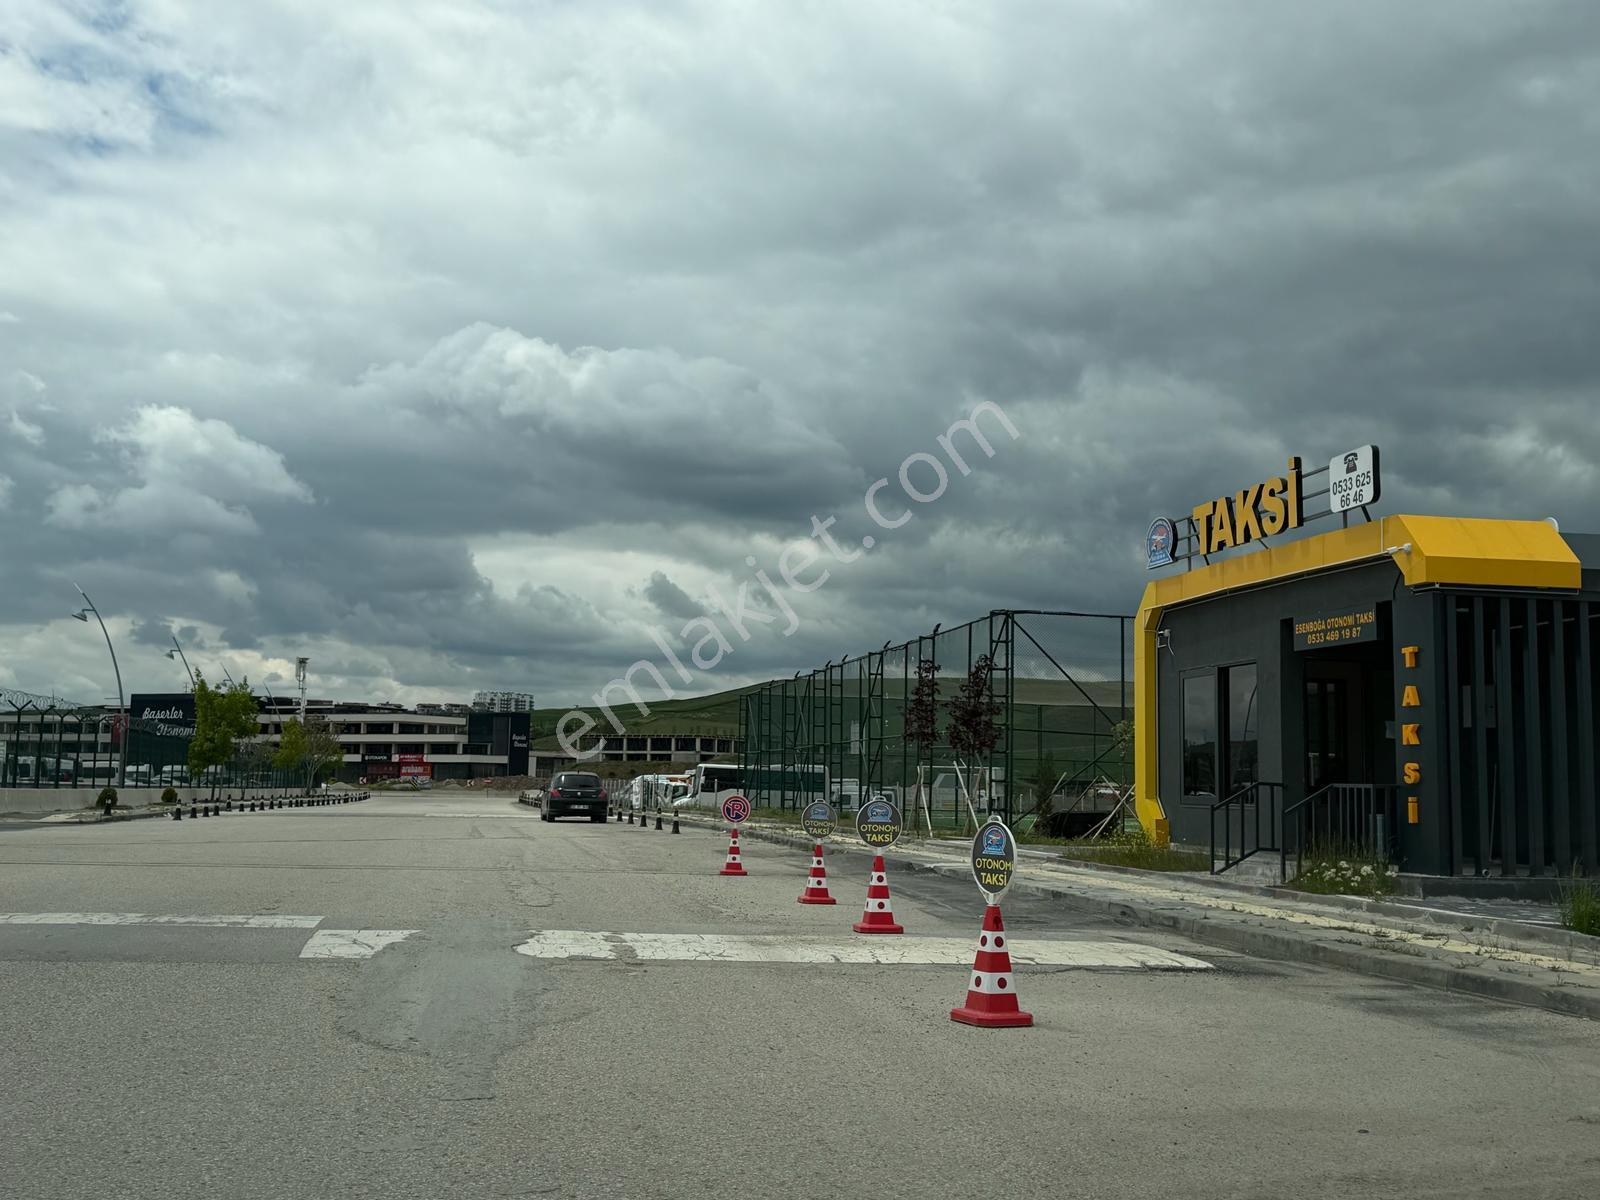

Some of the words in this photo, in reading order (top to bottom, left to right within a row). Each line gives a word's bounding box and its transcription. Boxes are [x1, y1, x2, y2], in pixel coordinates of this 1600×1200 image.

[1332, 477, 1353, 496] 0533
[1355, 470, 1371, 488] 625
[1192, 457, 1303, 556] TAKSİ
[1340, 493, 1351, 508] 66
[1352, 489, 1364, 504] 46
[1356, 609, 1375, 625] TAKSİ
[1307, 632, 1325, 645] 0533
[1342, 628, 1351, 639] 19
[1401, 645, 1421, 824] TAKSİ
[866, 833, 893, 842] TAKSİ
[980, 871, 1007, 886] TAKSİ
